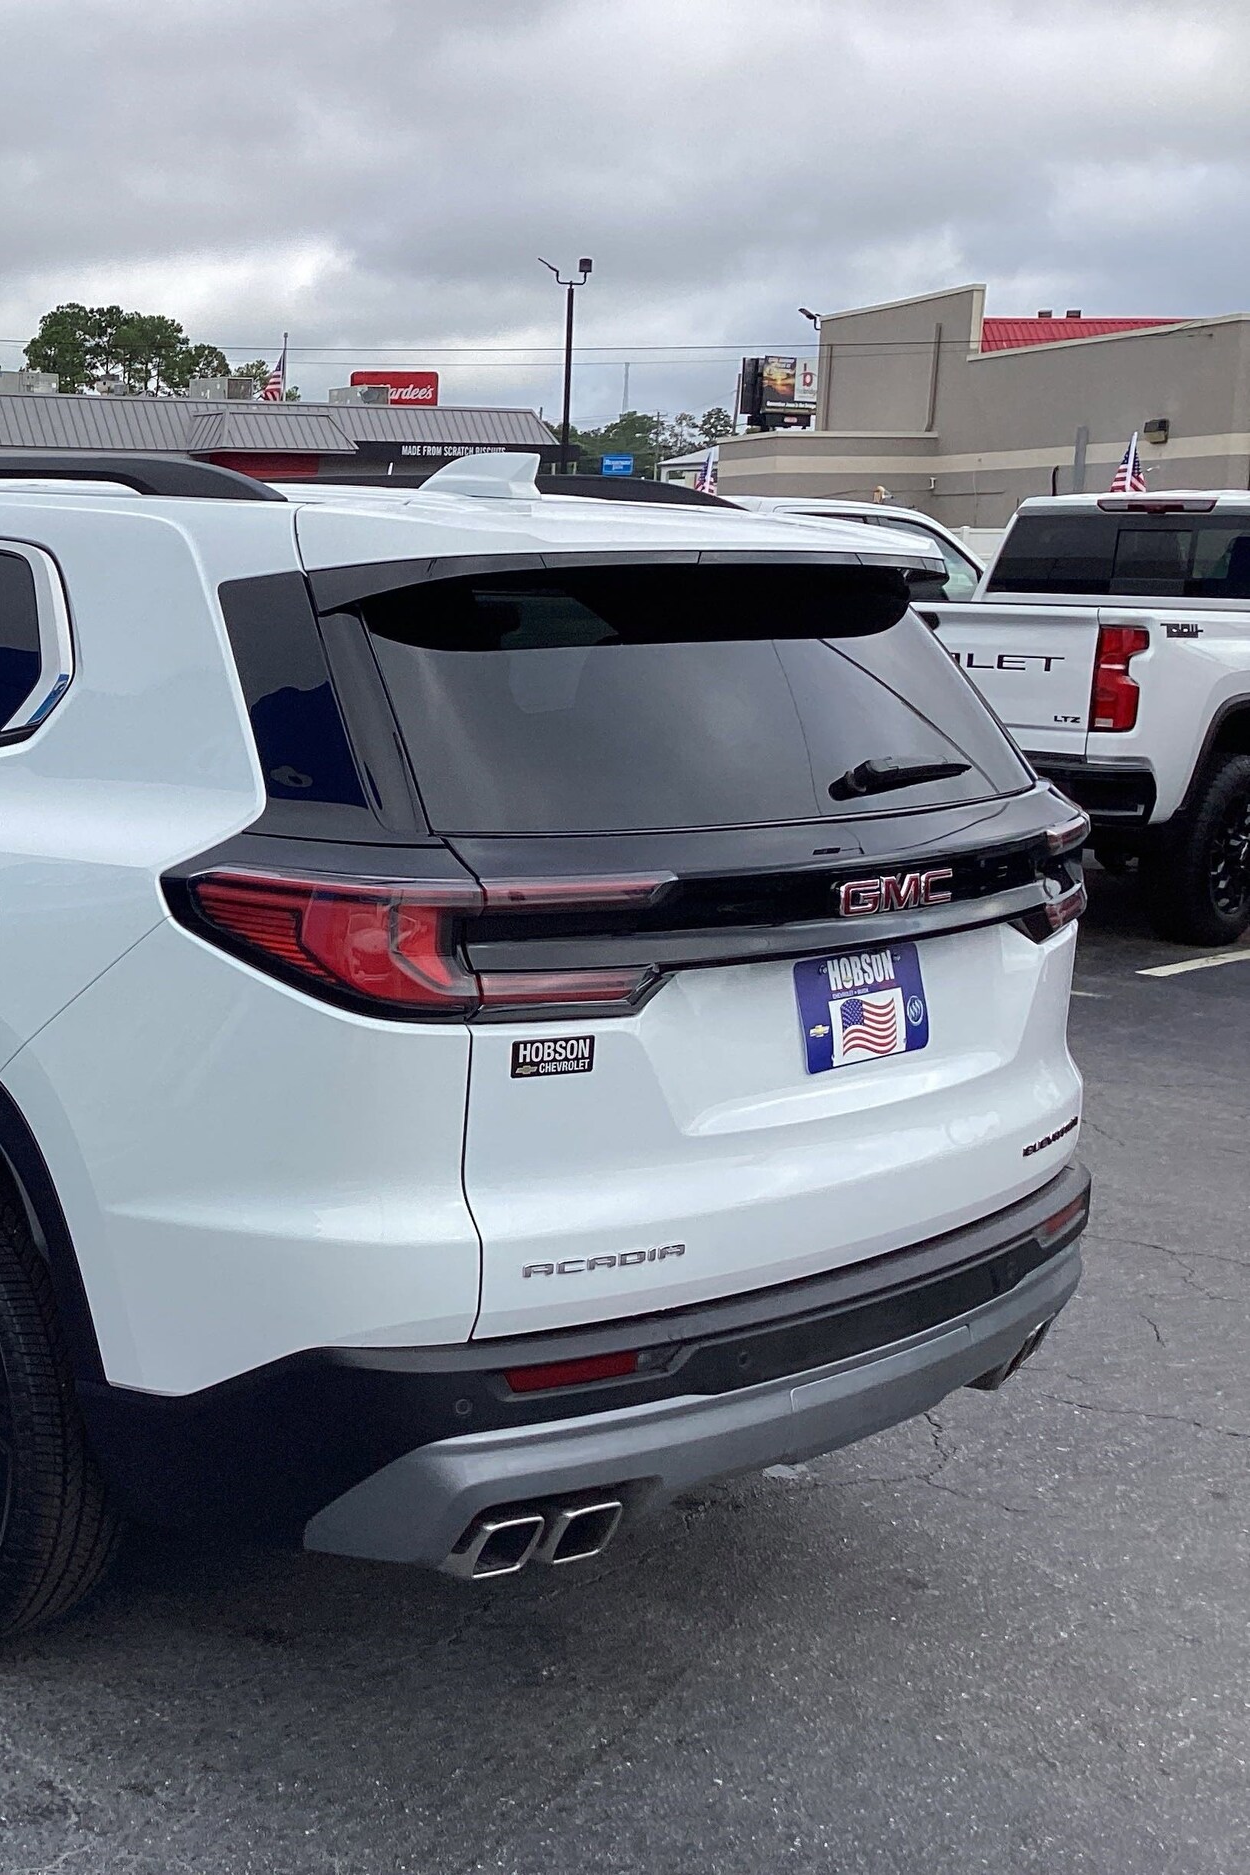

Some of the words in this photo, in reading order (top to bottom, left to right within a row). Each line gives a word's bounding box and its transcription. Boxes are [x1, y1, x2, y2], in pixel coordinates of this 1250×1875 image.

[388, 383, 434, 400] ardee's
[401, 445, 421, 456] MADE
[422, 445, 442, 456] FROM
[443, 446, 474, 456] SCRATCH
[1053, 715, 1081, 723] LTZ
[840, 868, 953, 917] GMC
[827, 949, 895, 991] HOBSON
[518, 1038, 590, 1063] HOBSON
[539, 1059, 590, 1074] CHEVROLET
[522, 1241, 686, 1278] ACADIA
